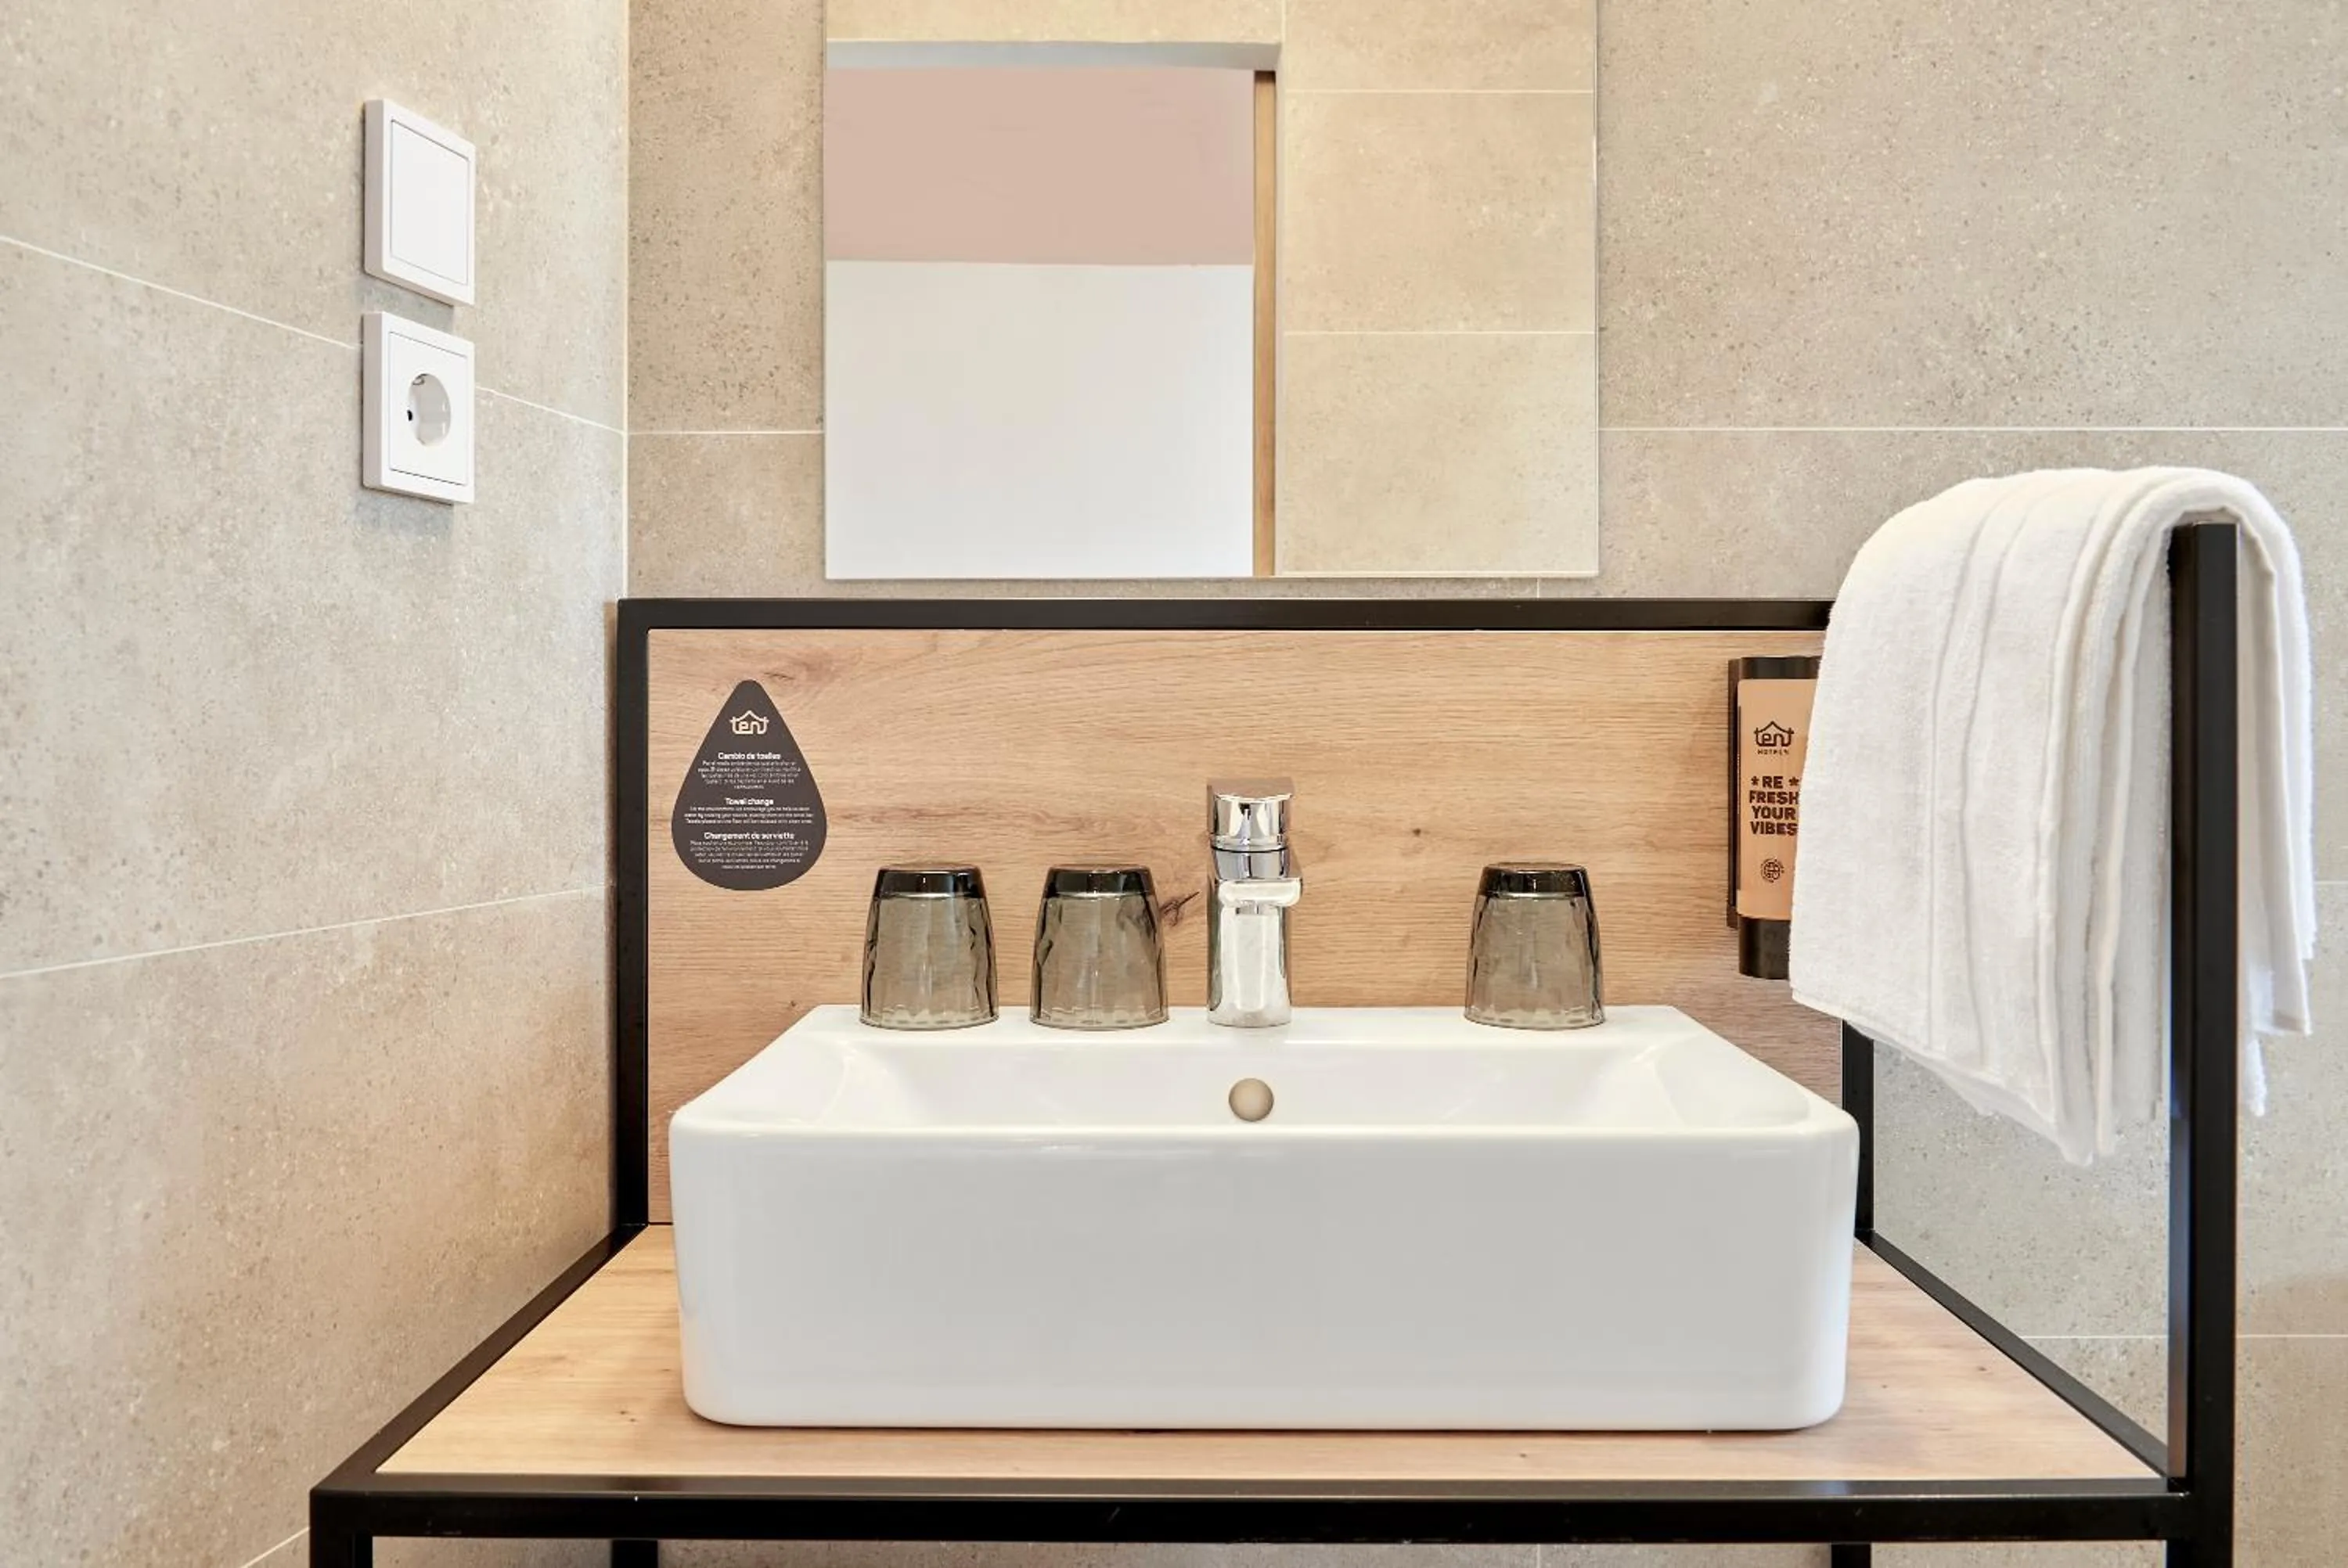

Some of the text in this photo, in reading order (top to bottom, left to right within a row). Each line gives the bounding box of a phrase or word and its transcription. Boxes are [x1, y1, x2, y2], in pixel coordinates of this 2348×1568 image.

[747, 797, 774, 807] change
[1749, 790, 1799, 804] FRESH
[1752, 805, 1796, 820] YOUR
[1750, 821, 1798, 836] VIBES
[704, 832, 751, 841] Changement
